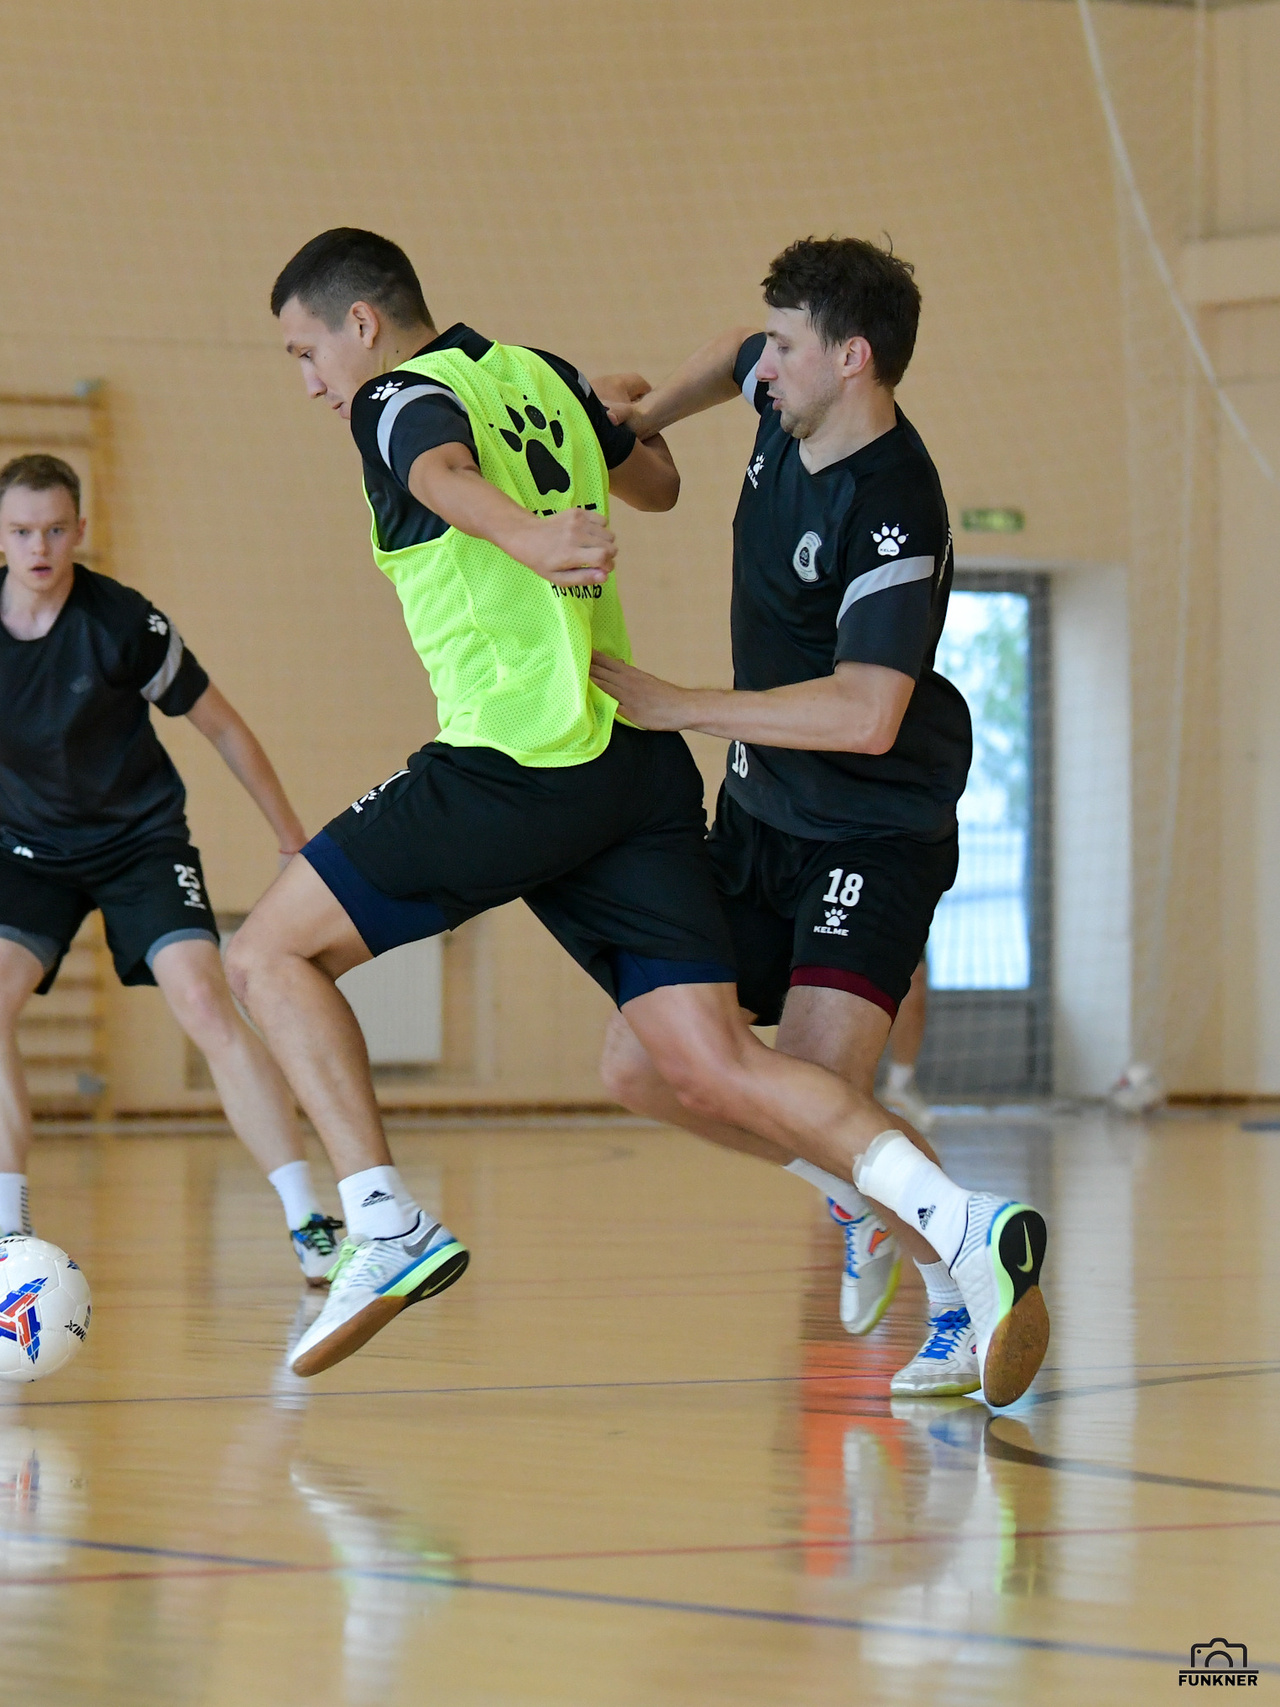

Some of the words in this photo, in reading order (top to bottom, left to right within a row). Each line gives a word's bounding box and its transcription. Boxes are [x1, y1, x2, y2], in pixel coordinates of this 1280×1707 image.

[731, 740, 749, 779] 18
[173, 863, 200, 890] 25
[822, 868, 864, 907] 18
[813, 925, 850, 936] KELME
